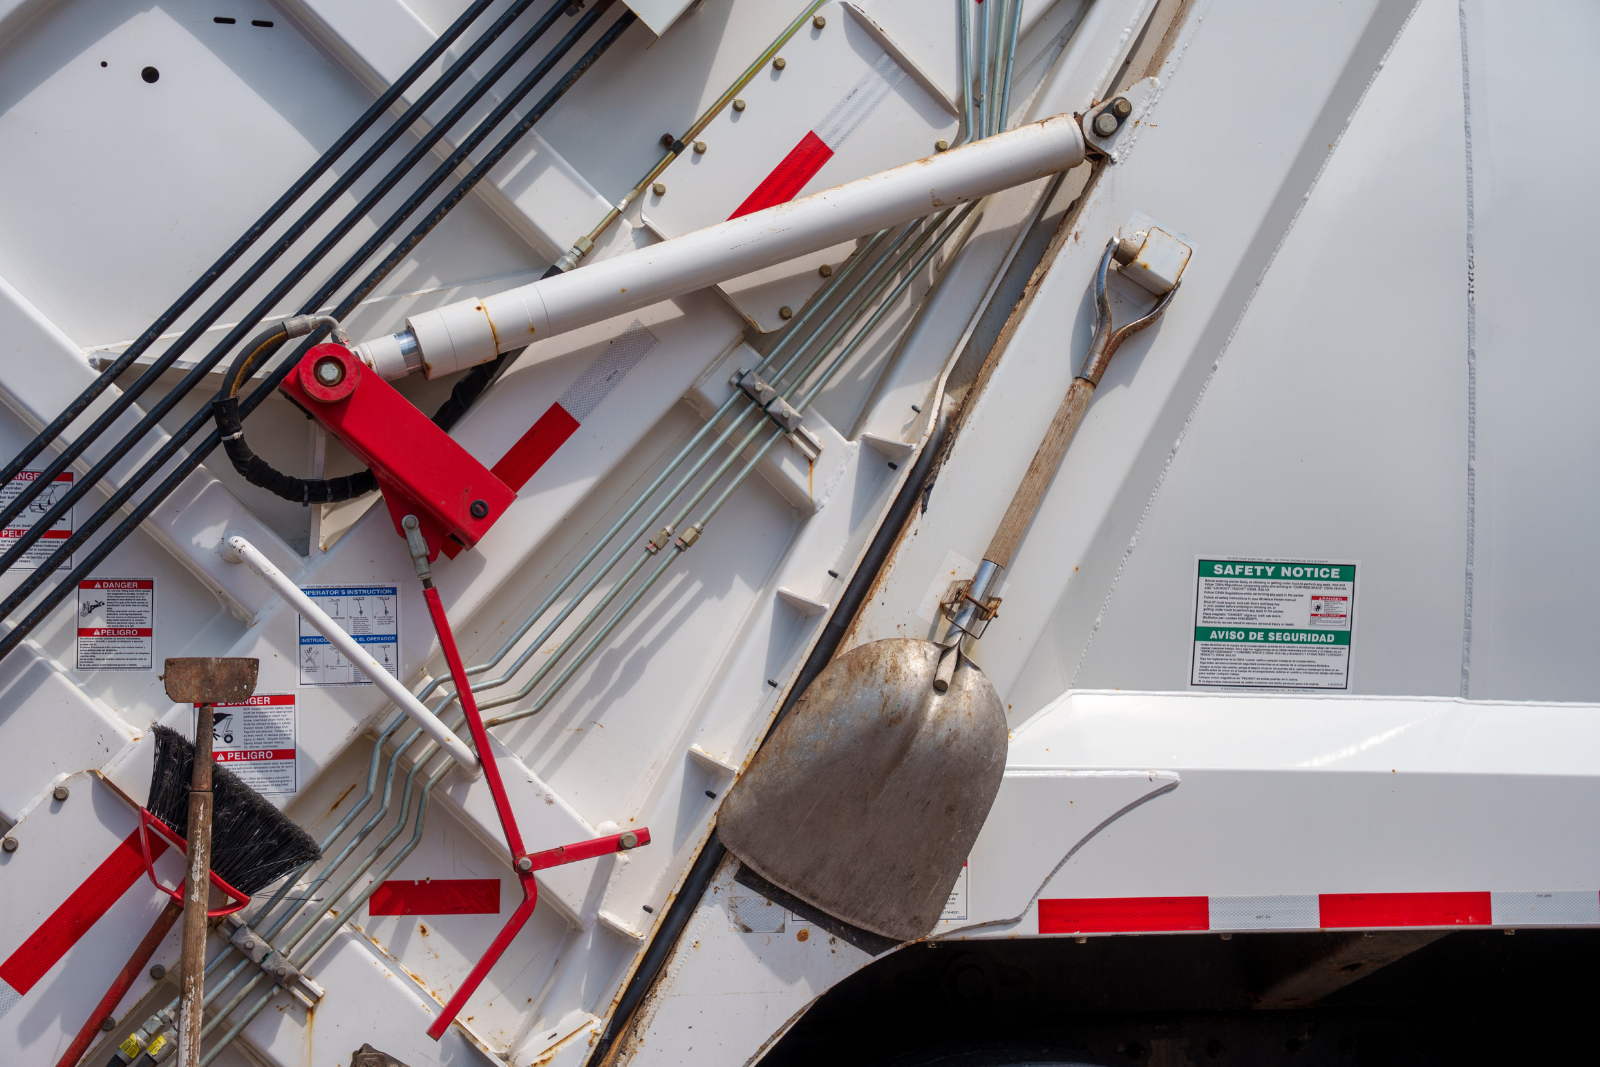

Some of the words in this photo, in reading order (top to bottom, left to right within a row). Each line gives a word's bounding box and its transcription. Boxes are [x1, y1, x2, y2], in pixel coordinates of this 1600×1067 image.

[1214, 564, 1276, 576] SAFETY
[1281, 566, 1340, 578] NOTICE
[1210, 631, 1245, 640] AVISO
[1249, 632, 1264, 640] DE
[1268, 632, 1335, 642] SEGURIDAD
[228, 697, 270, 705] NGER
[228, 751, 273, 760] PELIGRO
